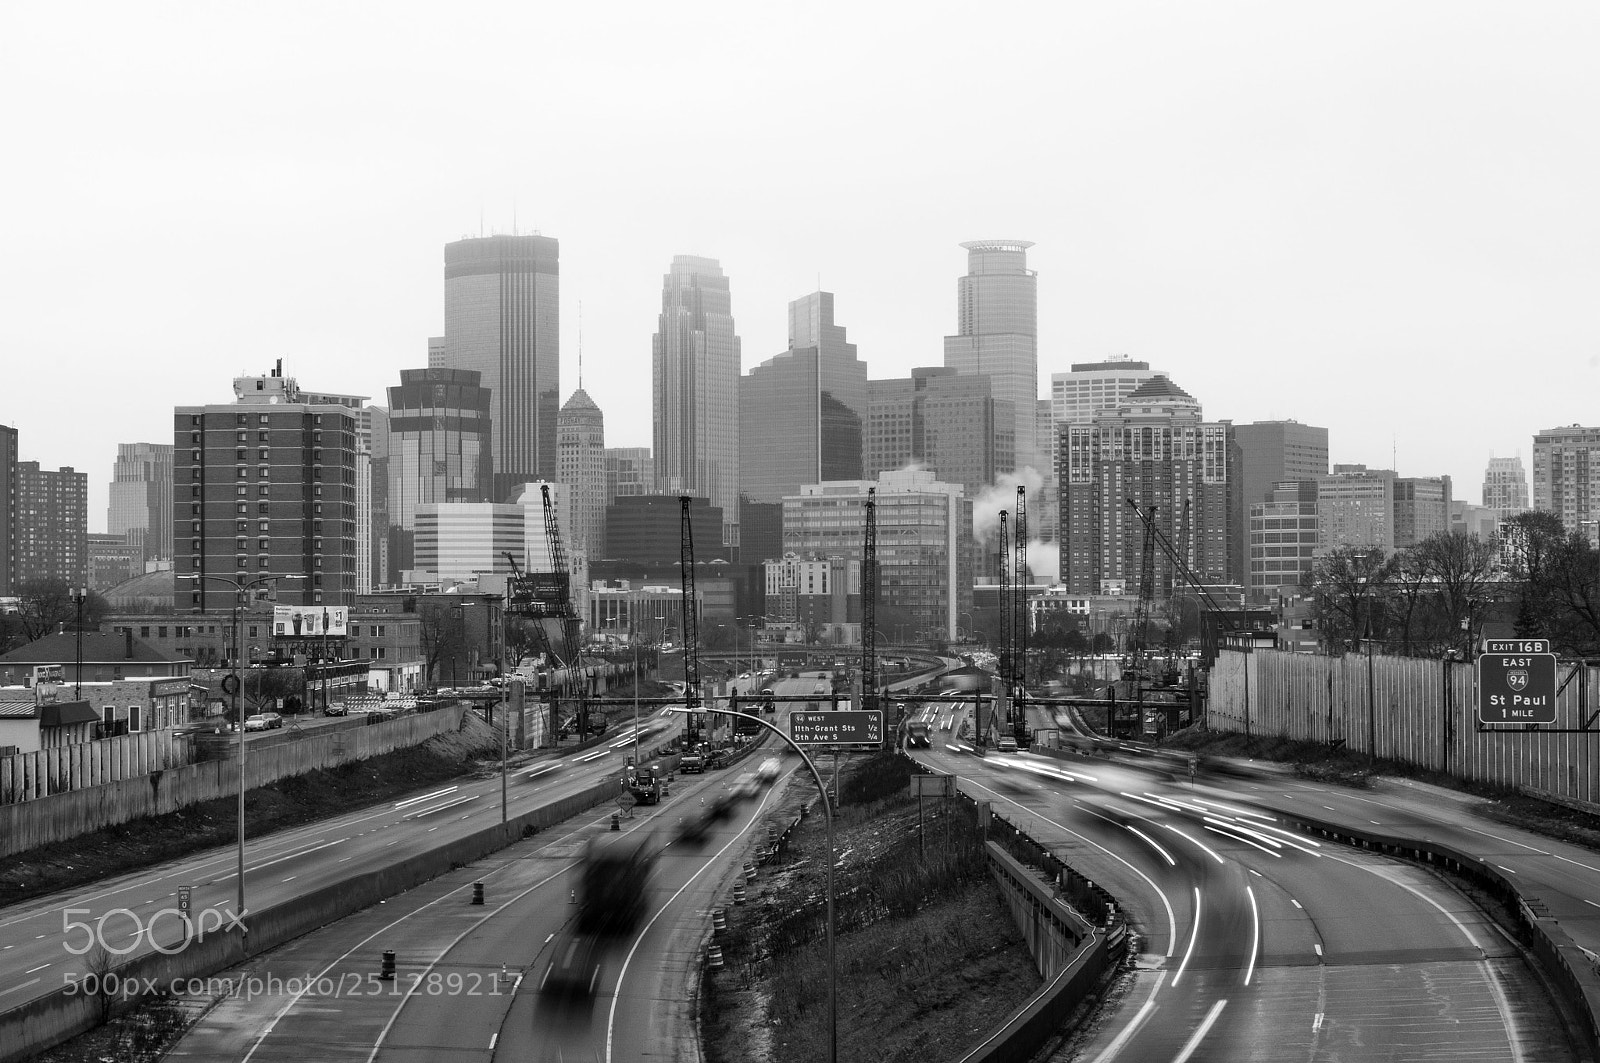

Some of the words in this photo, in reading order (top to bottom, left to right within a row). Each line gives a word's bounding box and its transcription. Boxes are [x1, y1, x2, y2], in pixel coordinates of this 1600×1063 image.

[1492, 643, 1514, 651] EXIT
[1518, 642, 1543, 652] 16B
[1502, 658, 1532, 667] EAST
[1510, 675, 1525, 685] 94
[1490, 695, 1506, 705] St
[1513, 695, 1546, 705] Paul
[1501, 708, 1507, 718] 1
[1511, 709, 1534, 717] MILE
[841, 724, 856, 732] Sts
